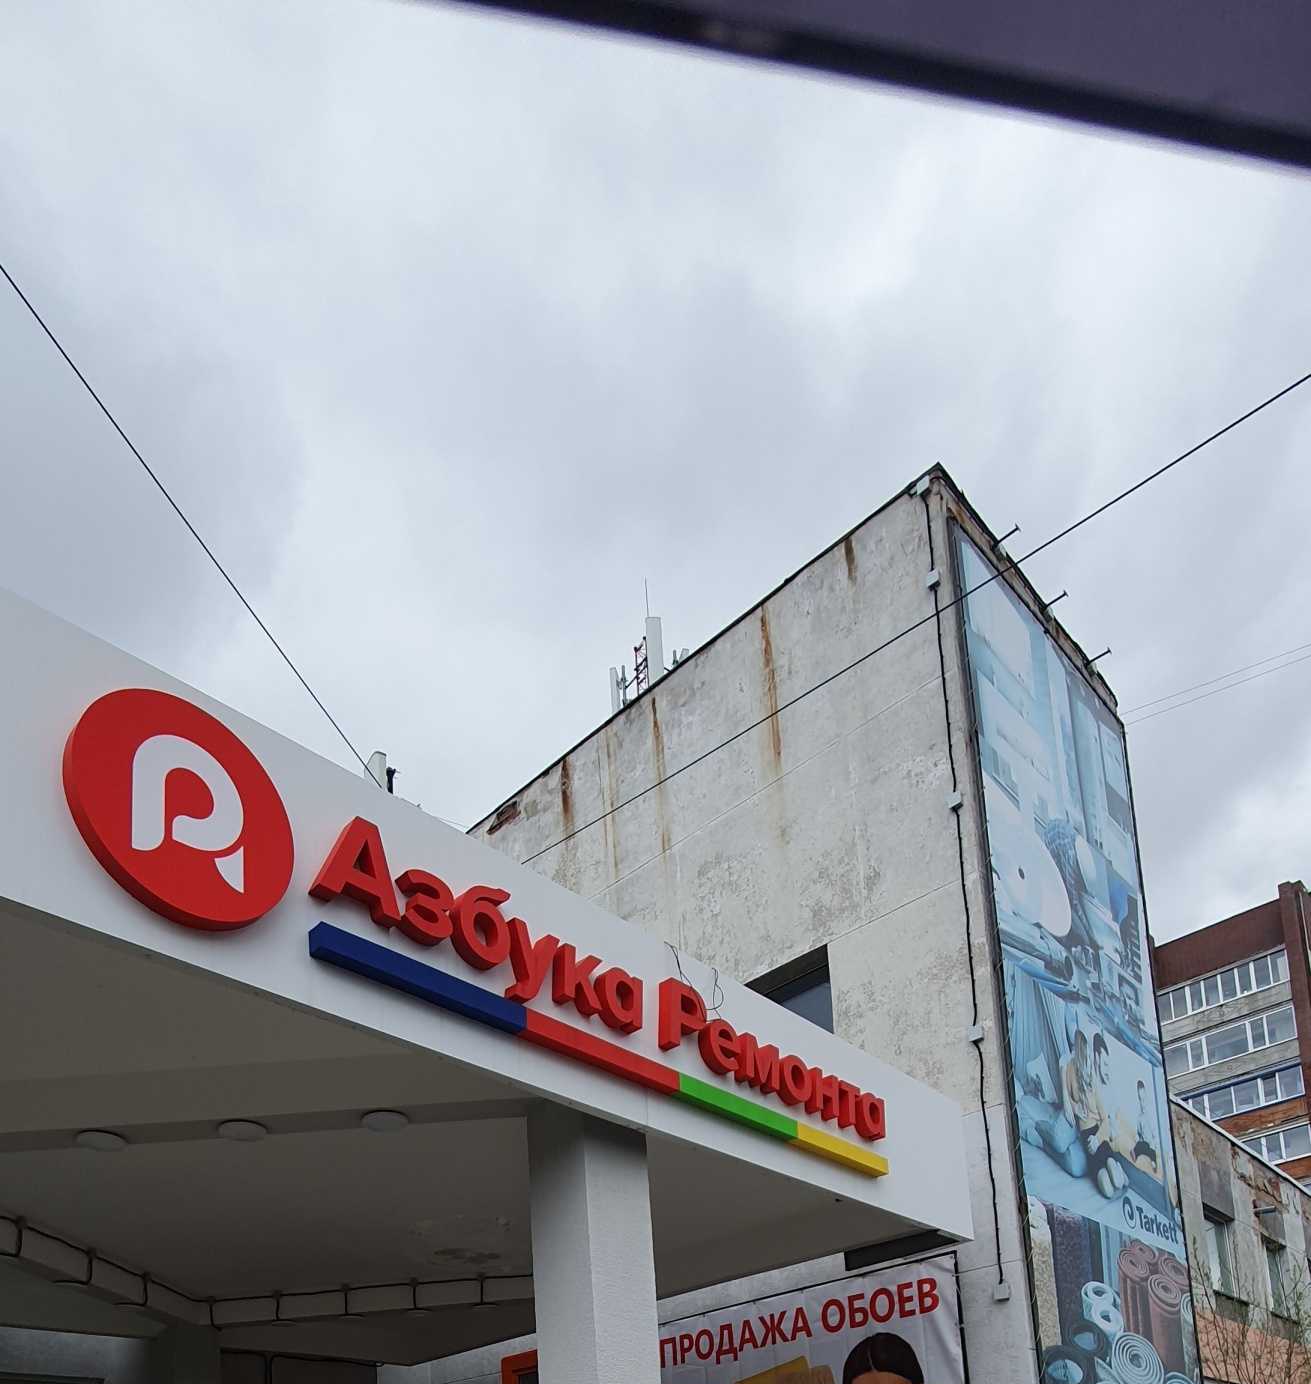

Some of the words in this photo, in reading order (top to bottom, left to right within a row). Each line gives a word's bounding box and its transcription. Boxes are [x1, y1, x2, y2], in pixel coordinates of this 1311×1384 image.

[310, 816, 644, 1034] Азбука
[657, 977, 887, 1142] Ремонта
[1136, 1205, 1179, 1244] Tarkett
[660, 1307, 813, 1368] ПРОДАЖА
[820, 1277, 940, 1333] ОБОЕВ
